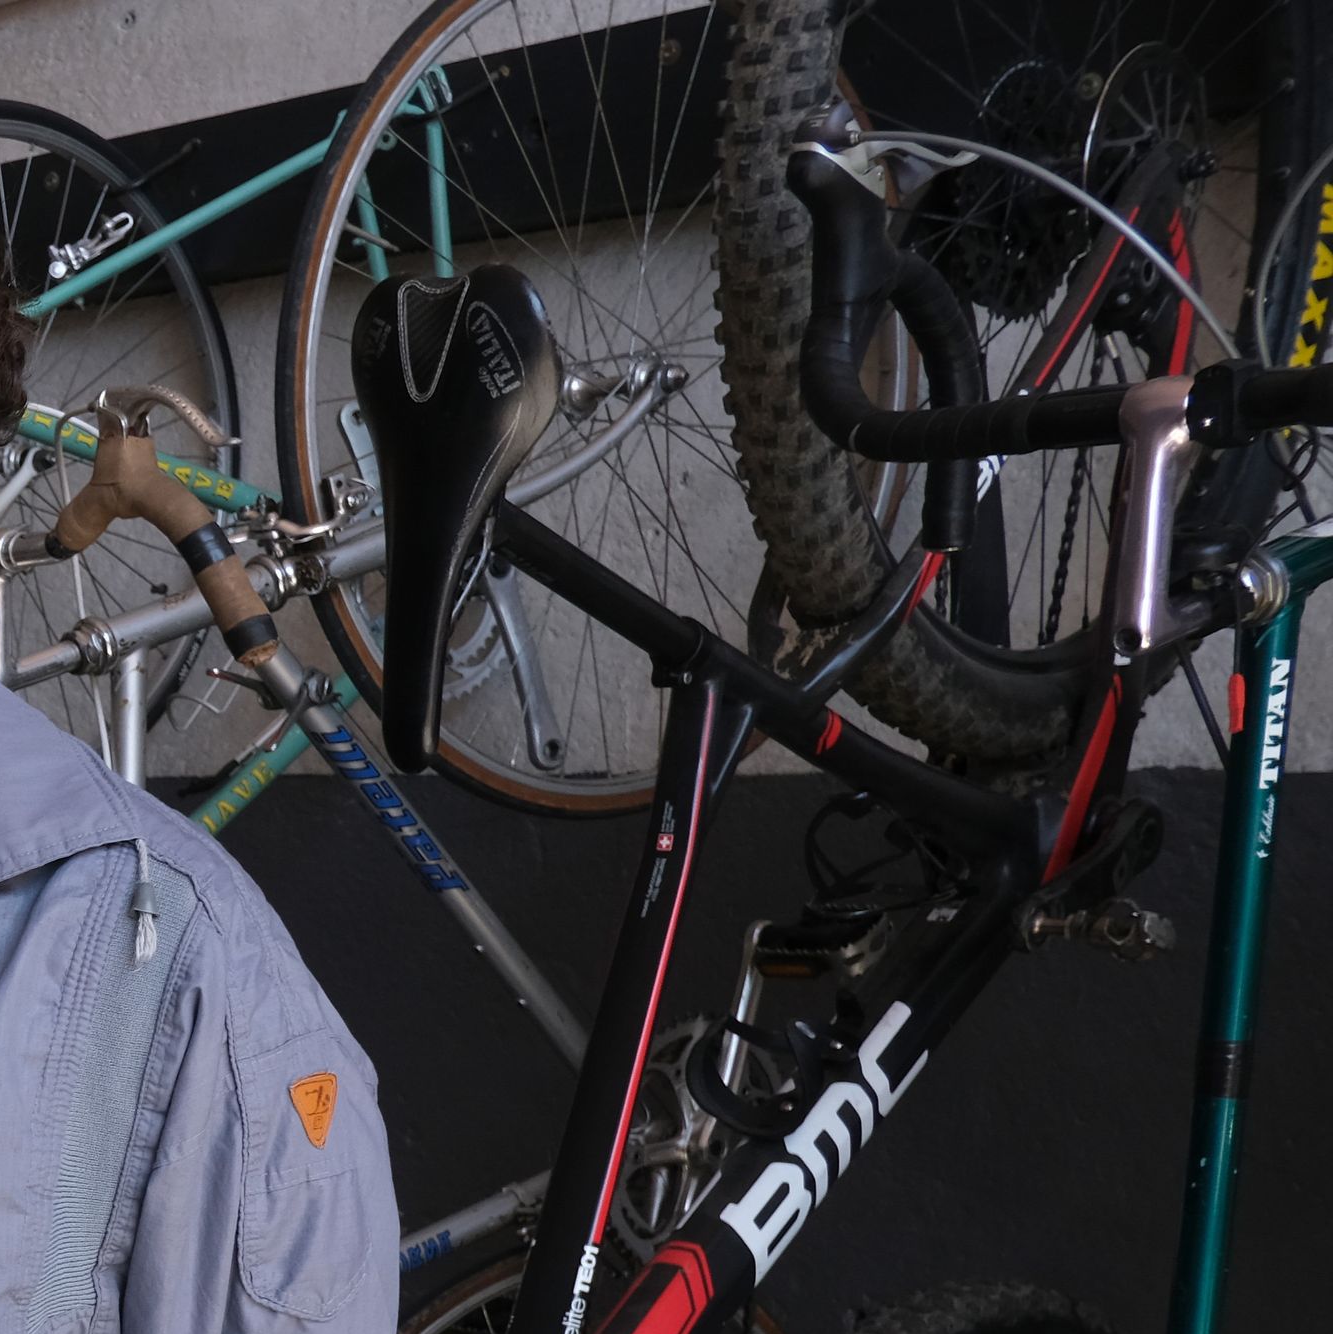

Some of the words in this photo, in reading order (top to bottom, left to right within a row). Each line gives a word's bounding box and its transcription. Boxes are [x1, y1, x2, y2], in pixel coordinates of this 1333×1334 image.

[470, 312, 522, 395] ITALIA
[1259, 657, 1291, 790] TITAN
[199, 759, 276, 836] IAVE
[309, 724, 471, 893] Patelli
[719, 1000, 929, 1289] BMC
